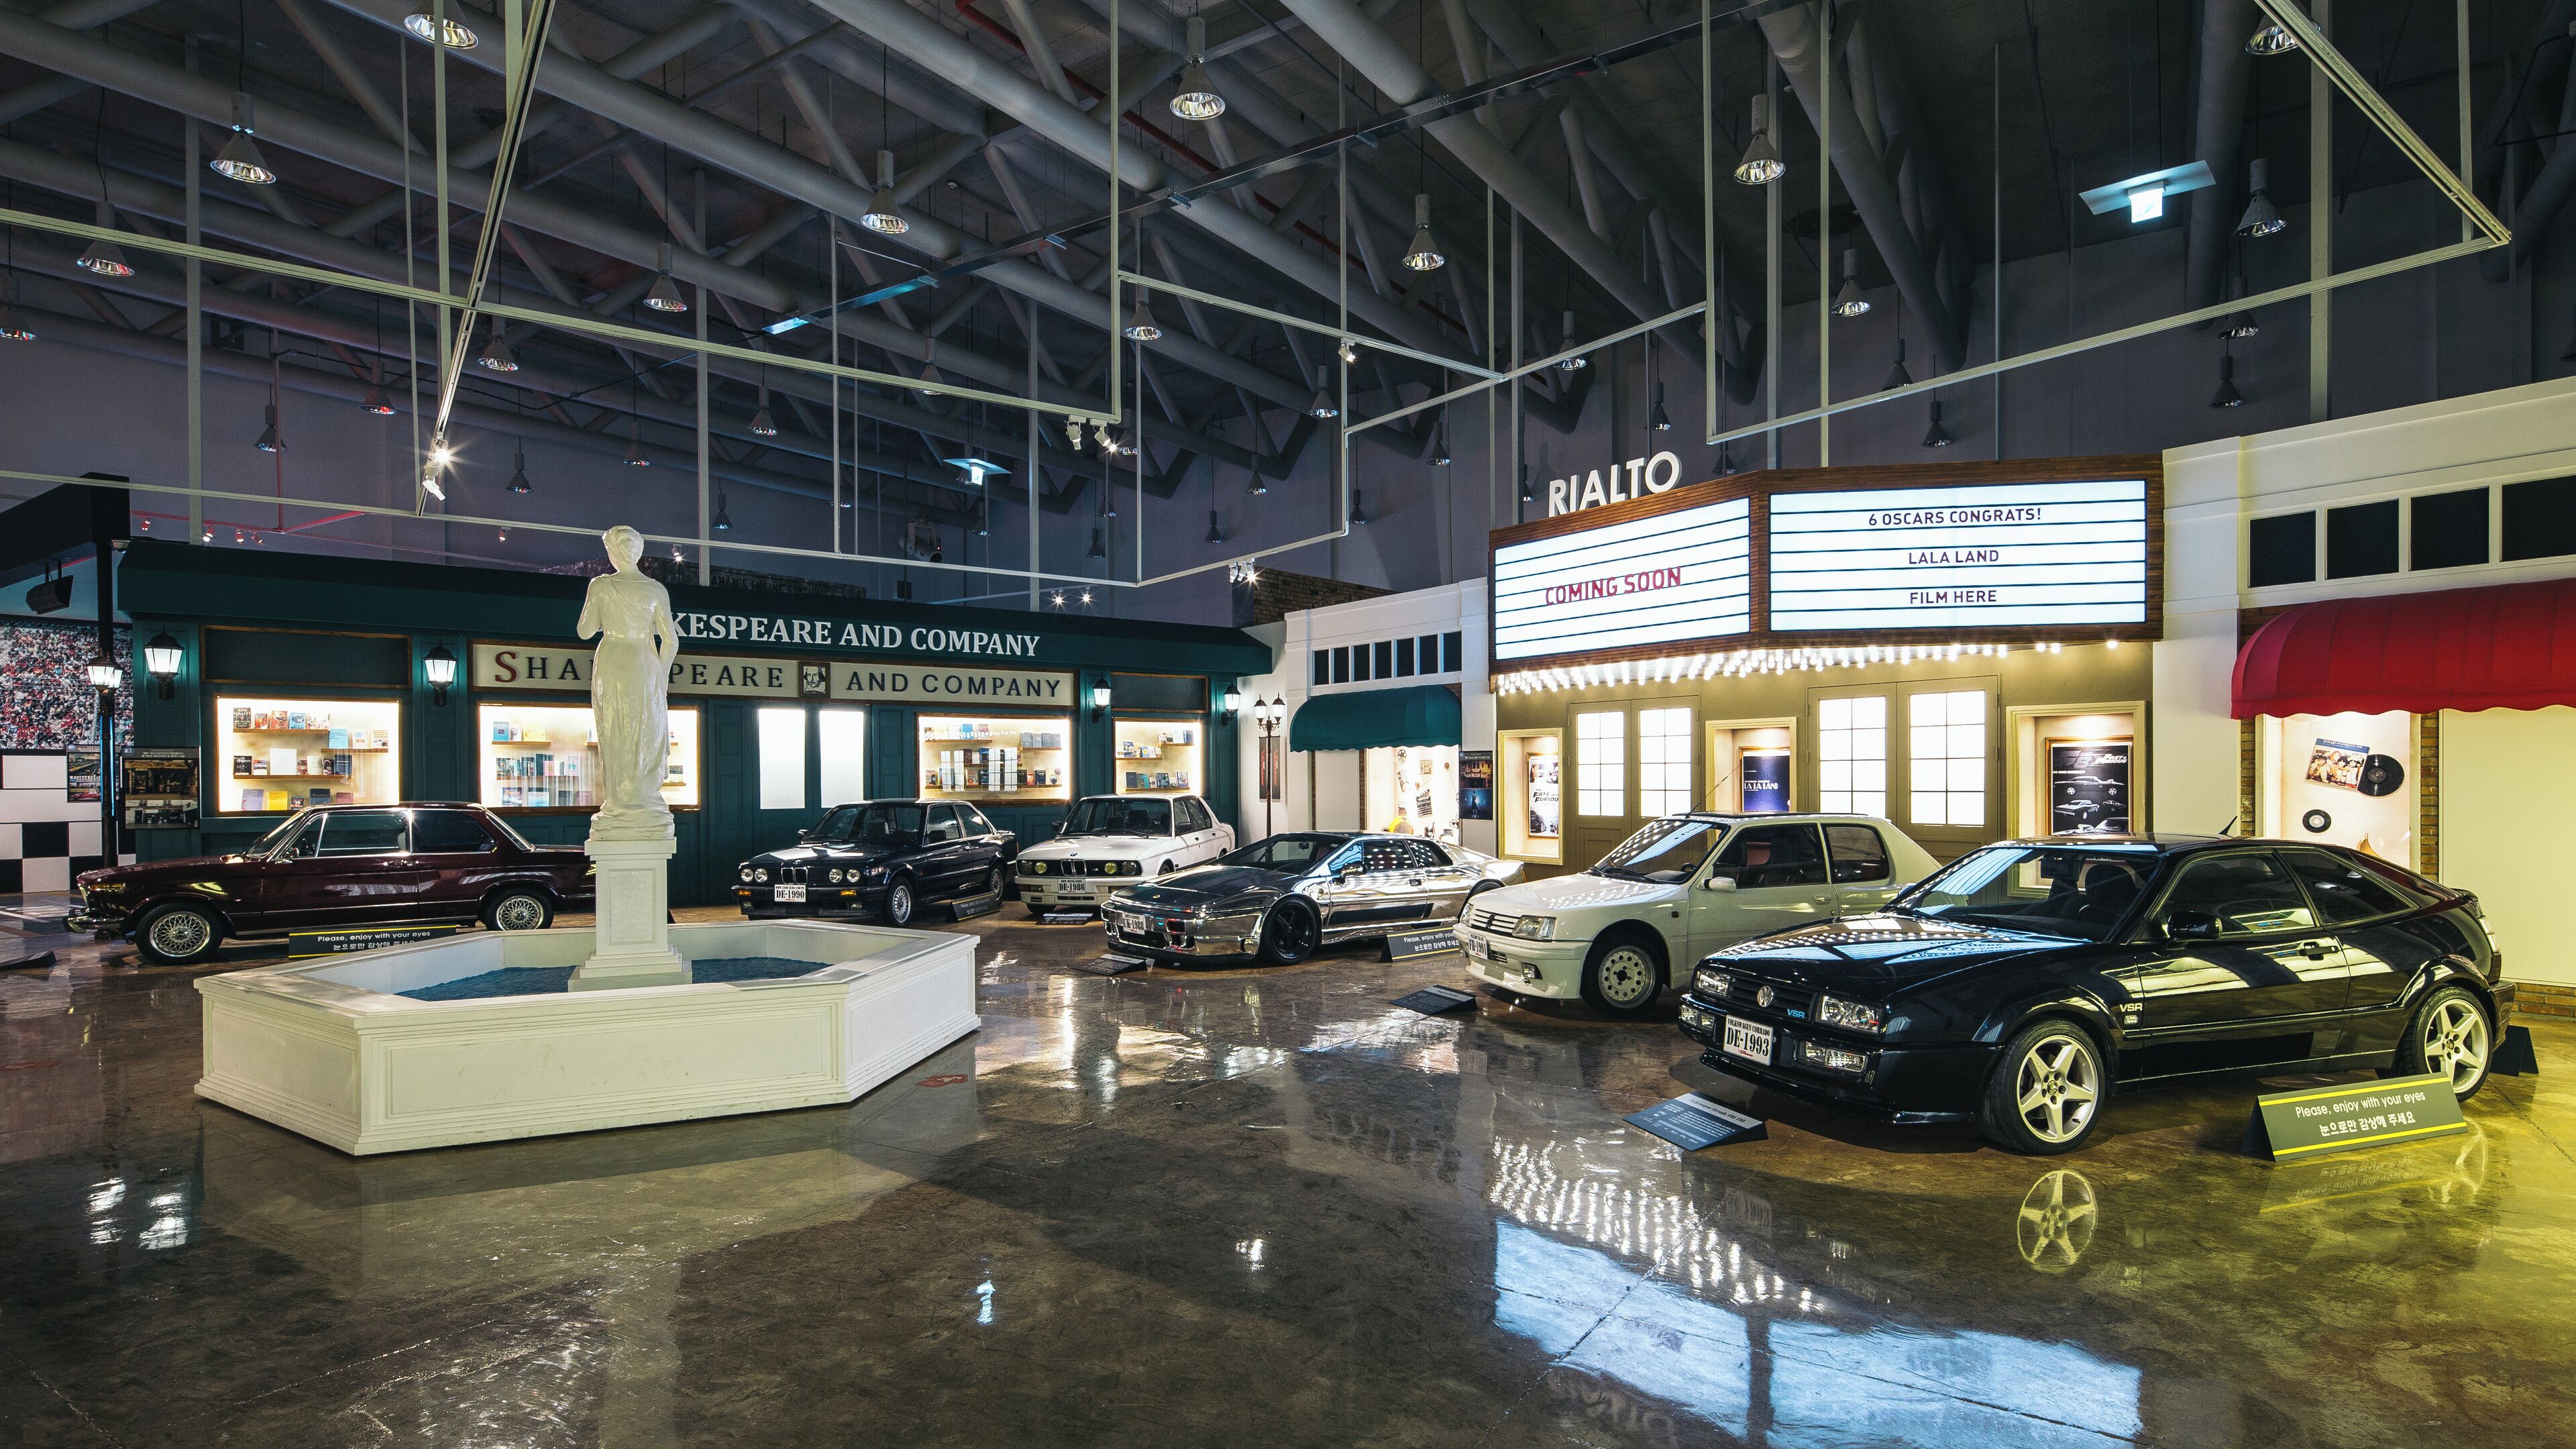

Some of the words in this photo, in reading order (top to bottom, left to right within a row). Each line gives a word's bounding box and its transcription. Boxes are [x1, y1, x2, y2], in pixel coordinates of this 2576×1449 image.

[1548, 451, 1682, 517] RIALTO
[1868, 513, 1878, 526] 6
[1882, 512, 1945, 525] OSCARS
[1949, 508, 2042, 523] CONGRATS!
[1909, 551, 1950, 565] LALA
[1955, 549, 1999, 563] LAND
[1545, 577, 1618, 606] COMING
[1623, 566, 1682, 594] SOON
[1910, 592, 1948, 604] FILM
[1953, 590, 1997, 602] HERE
[671, 612, 832, 645] KESPEARE
[839, 622, 903, 649] AND
[910, 628, 1040, 657] COMPANY
[494, 651, 784, 688] SHAPEARE
[845, 670, 909, 692] AND
[922, 673, 1061, 698] COMPANY
[776, 890, 805, 899] DE-1990
[1059, 883, 1085, 891] DE-1986
[1123, 918, 1144, 931] UK-1988
[1786, 1008, 1805, 1019] VSR
[2119, 1002, 2143, 1012] VSR
[1727, 1018, 1752, 1031] VOLKSWAGEN
[1752, 1025, 1770, 1036] CORRADO
[1726, 1027, 1770, 1057] DE-1993
[2295, 1106, 2332, 1118] Please,
[2332, 1100, 2359, 1113] enjoy
[2361, 1096, 2381, 1109] with
[2381, 1094, 2402, 1108] your
[2404, 1091, 2426, 1104] eyes
[2319, 1119, 2358, 1137] 눈으로만
[2358, 1115, 2387, 1131] 감상해
[2387, 1111, 2416, 1127] 주세요
